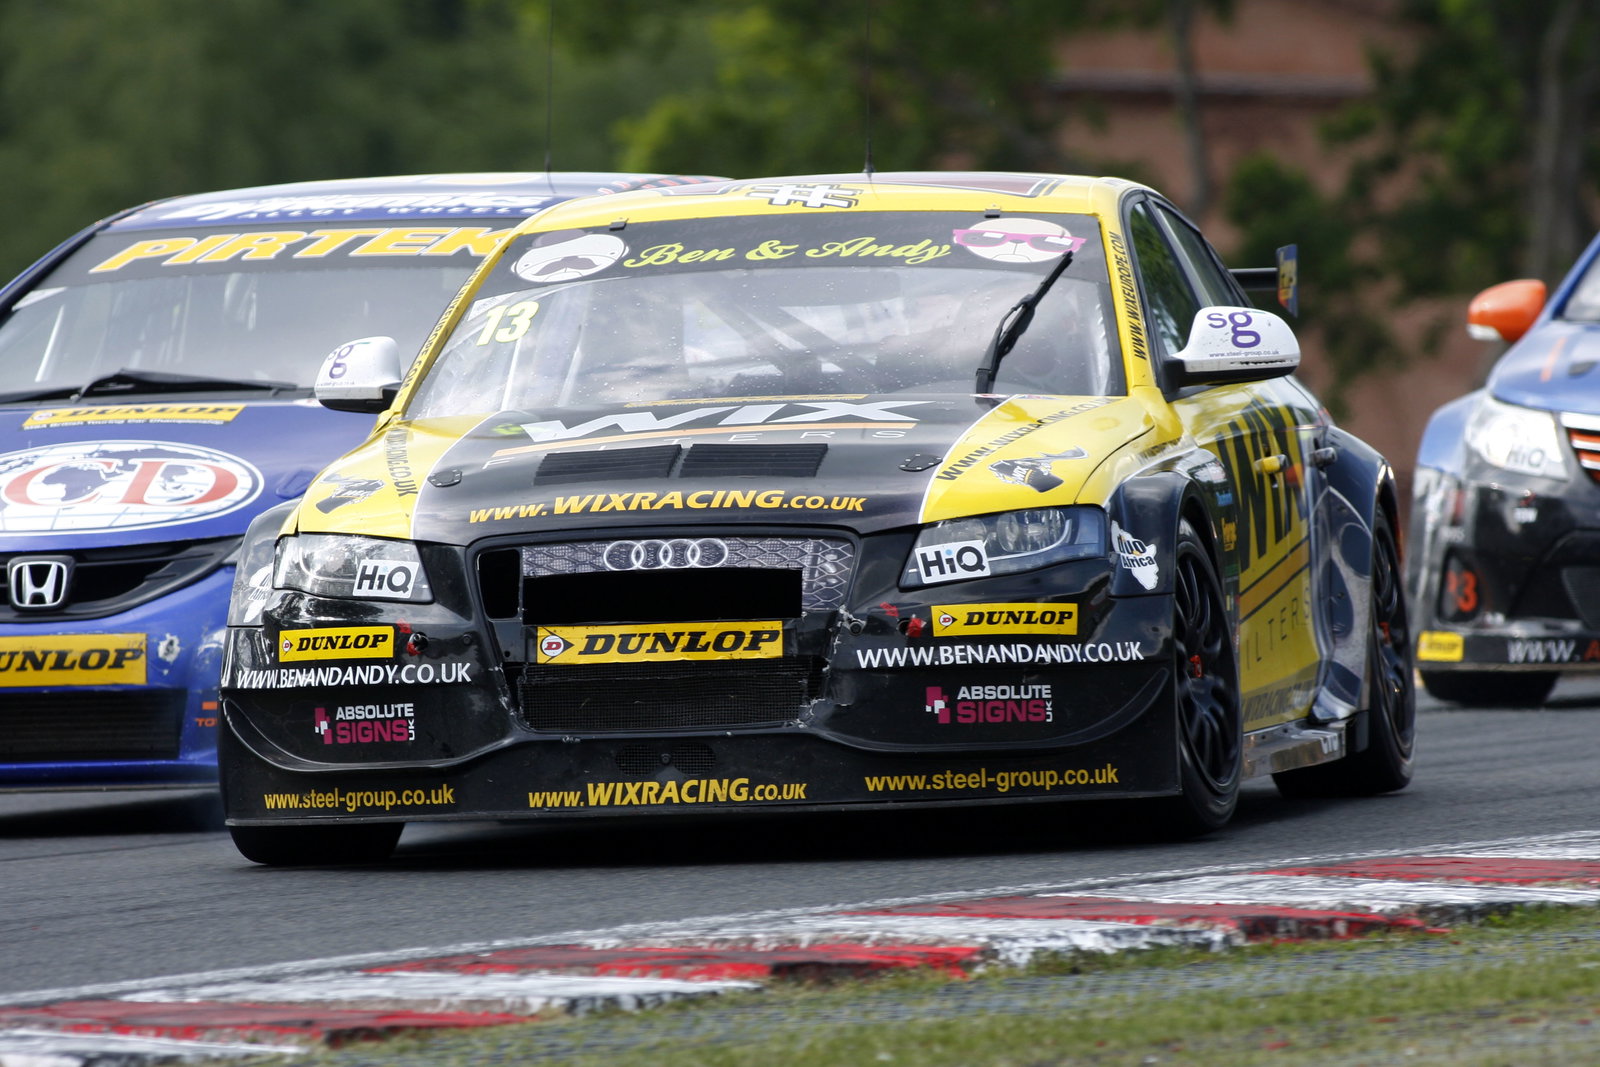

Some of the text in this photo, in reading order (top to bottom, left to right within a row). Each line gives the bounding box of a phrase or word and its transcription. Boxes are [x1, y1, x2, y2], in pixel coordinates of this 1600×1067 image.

[90, 226, 512, 273] PIRTEK
[623, 236, 951, 268] Ben & Andy
[476, 301, 539, 347] 13
[1207, 311, 1261, 348] sg
[520, 400, 936, 443] WIX
[3, 458, 239, 507] CD
[920, 545, 986, 578] HiQ
[1121, 556, 1156, 568] Africa
[963, 610, 1073, 626] DUNLOP
[297, 634, 389, 651] DUNLOP
[578, 629, 781, 656] DUNLOP
[856, 641, 1145, 669] WWW.BENANDANDY.CO.UK
[0, 648, 144, 672] UNLOP
[236, 662, 472, 689] WWW.BENANDANDY.CO.UK
[957, 684, 1052, 700] ABSOLUTE
[335, 703, 414, 721] ABSOLUTE
[957, 700, 1053, 723] SIGNS UK
[336, 719, 415, 744] SIGNS UK
[864, 763, 1119, 793] www.steel-group.co.uk
[264, 783, 456, 812] www.steel-group.co.uk
